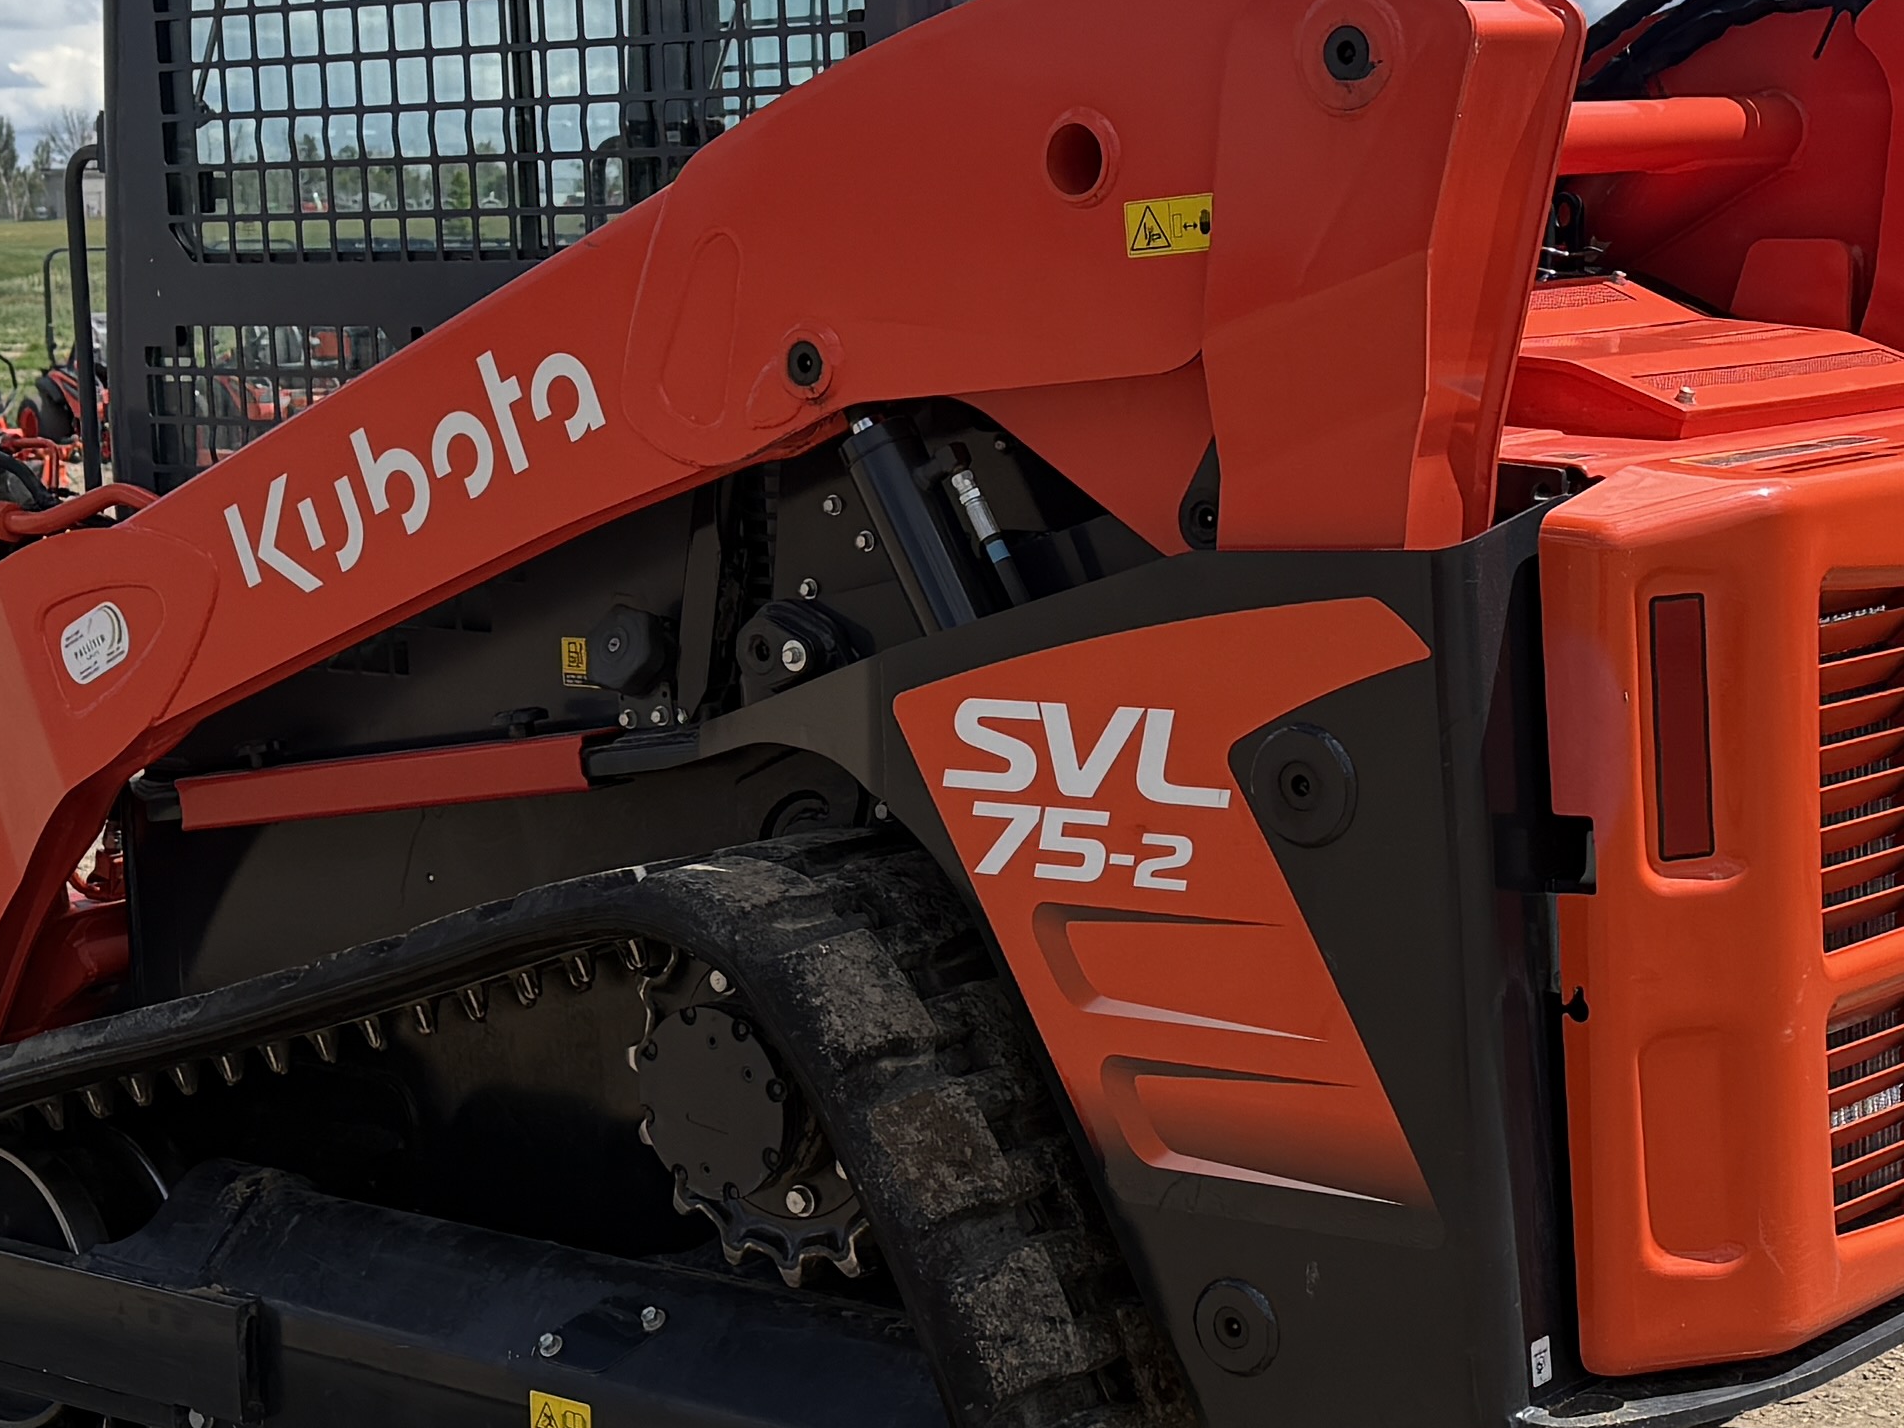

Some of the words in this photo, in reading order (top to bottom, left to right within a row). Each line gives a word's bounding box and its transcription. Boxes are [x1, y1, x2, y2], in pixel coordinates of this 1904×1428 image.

[223, 349, 607, 594] Kubota
[942, 697, 1231, 809] SVL
[972, 800, 1194, 892] 75-2
